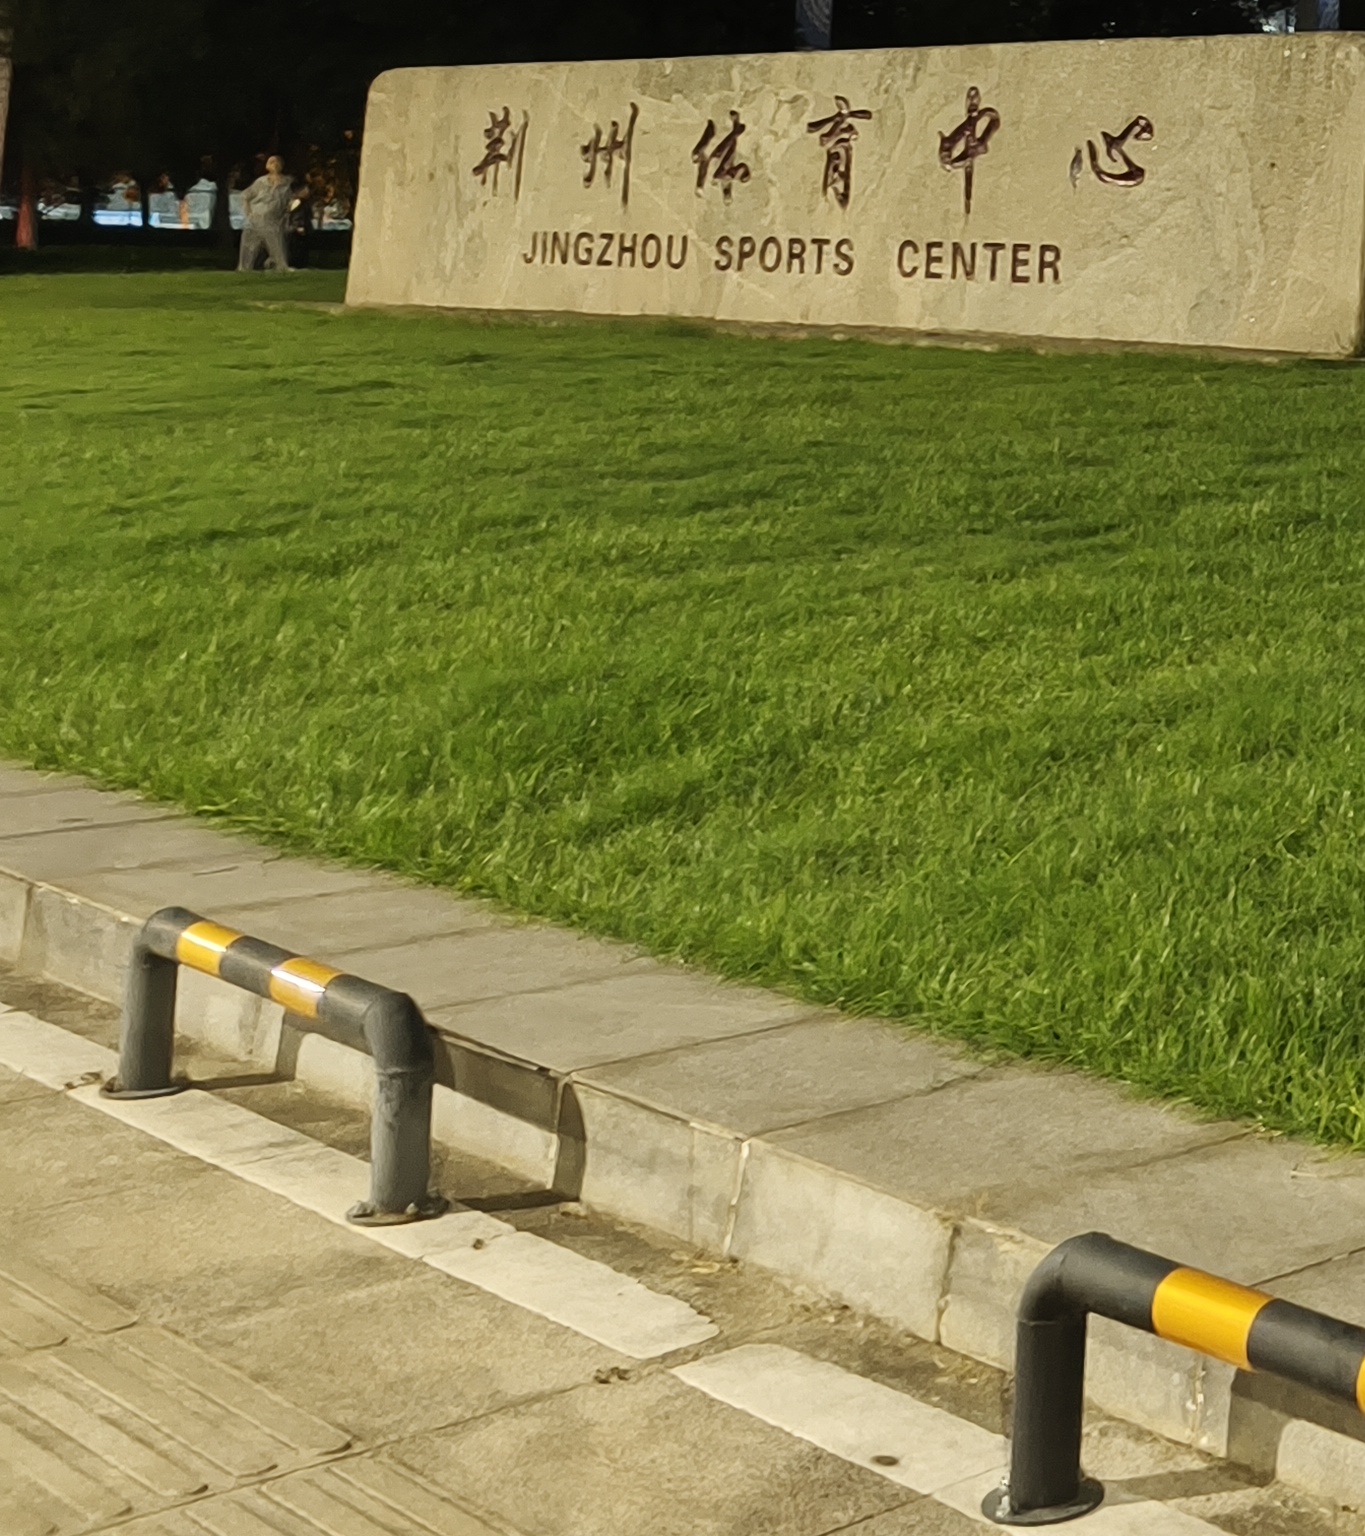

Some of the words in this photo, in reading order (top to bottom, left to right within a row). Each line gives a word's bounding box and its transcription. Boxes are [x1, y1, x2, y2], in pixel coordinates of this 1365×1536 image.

[472, 86, 1154, 216] 荆州体育中心
[523, 231, 689, 269] JINGZHOU
[714, 236, 855, 276] SPORTS
[898, 239, 1062, 284] CENTER
